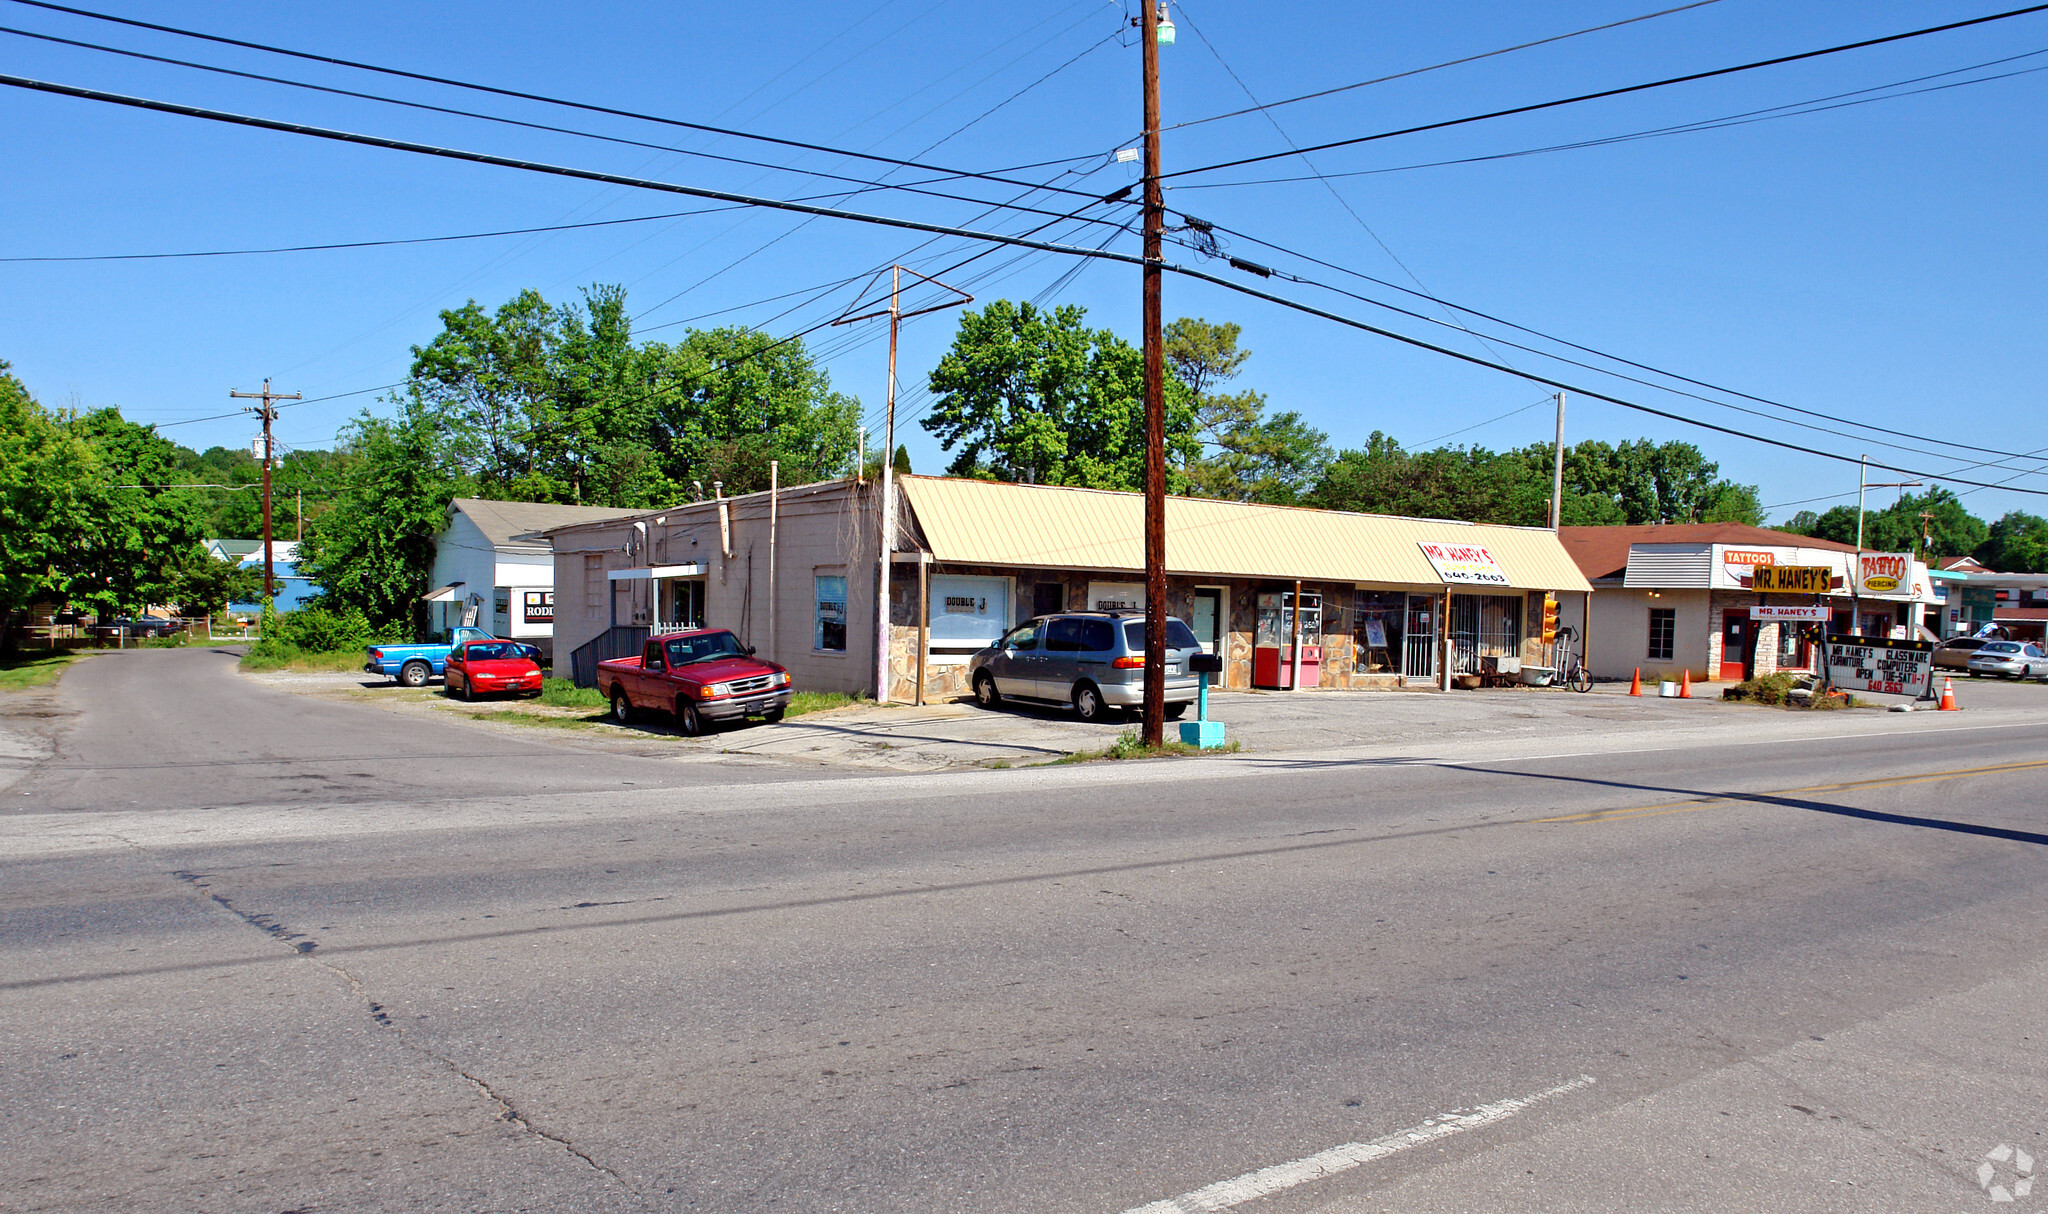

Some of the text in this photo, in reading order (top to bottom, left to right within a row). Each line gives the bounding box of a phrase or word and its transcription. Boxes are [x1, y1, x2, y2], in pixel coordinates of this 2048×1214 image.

[1727, 552, 1772, 564] TATTOOS
[1861, 556, 1906, 580] TATTOO
[1754, 568, 1775, 589] MR.
[1778, 568, 1829, 590] HANEY'S
[946, 596, 986, 610] DOUBLE J
[1098, 600, 1126, 610] DOUBLE
[1759, 608, 1817, 617] MR. HANEY'S
[1832, 645, 1843, 656] MR
[1886, 650, 1927, 662] GLASSWARE
[1830, 655, 1918, 673] FURNITURE COMPUTERS
[1856, 668, 1873, 680] OPEN
[1868, 680, 1903, 693] 640 2663
